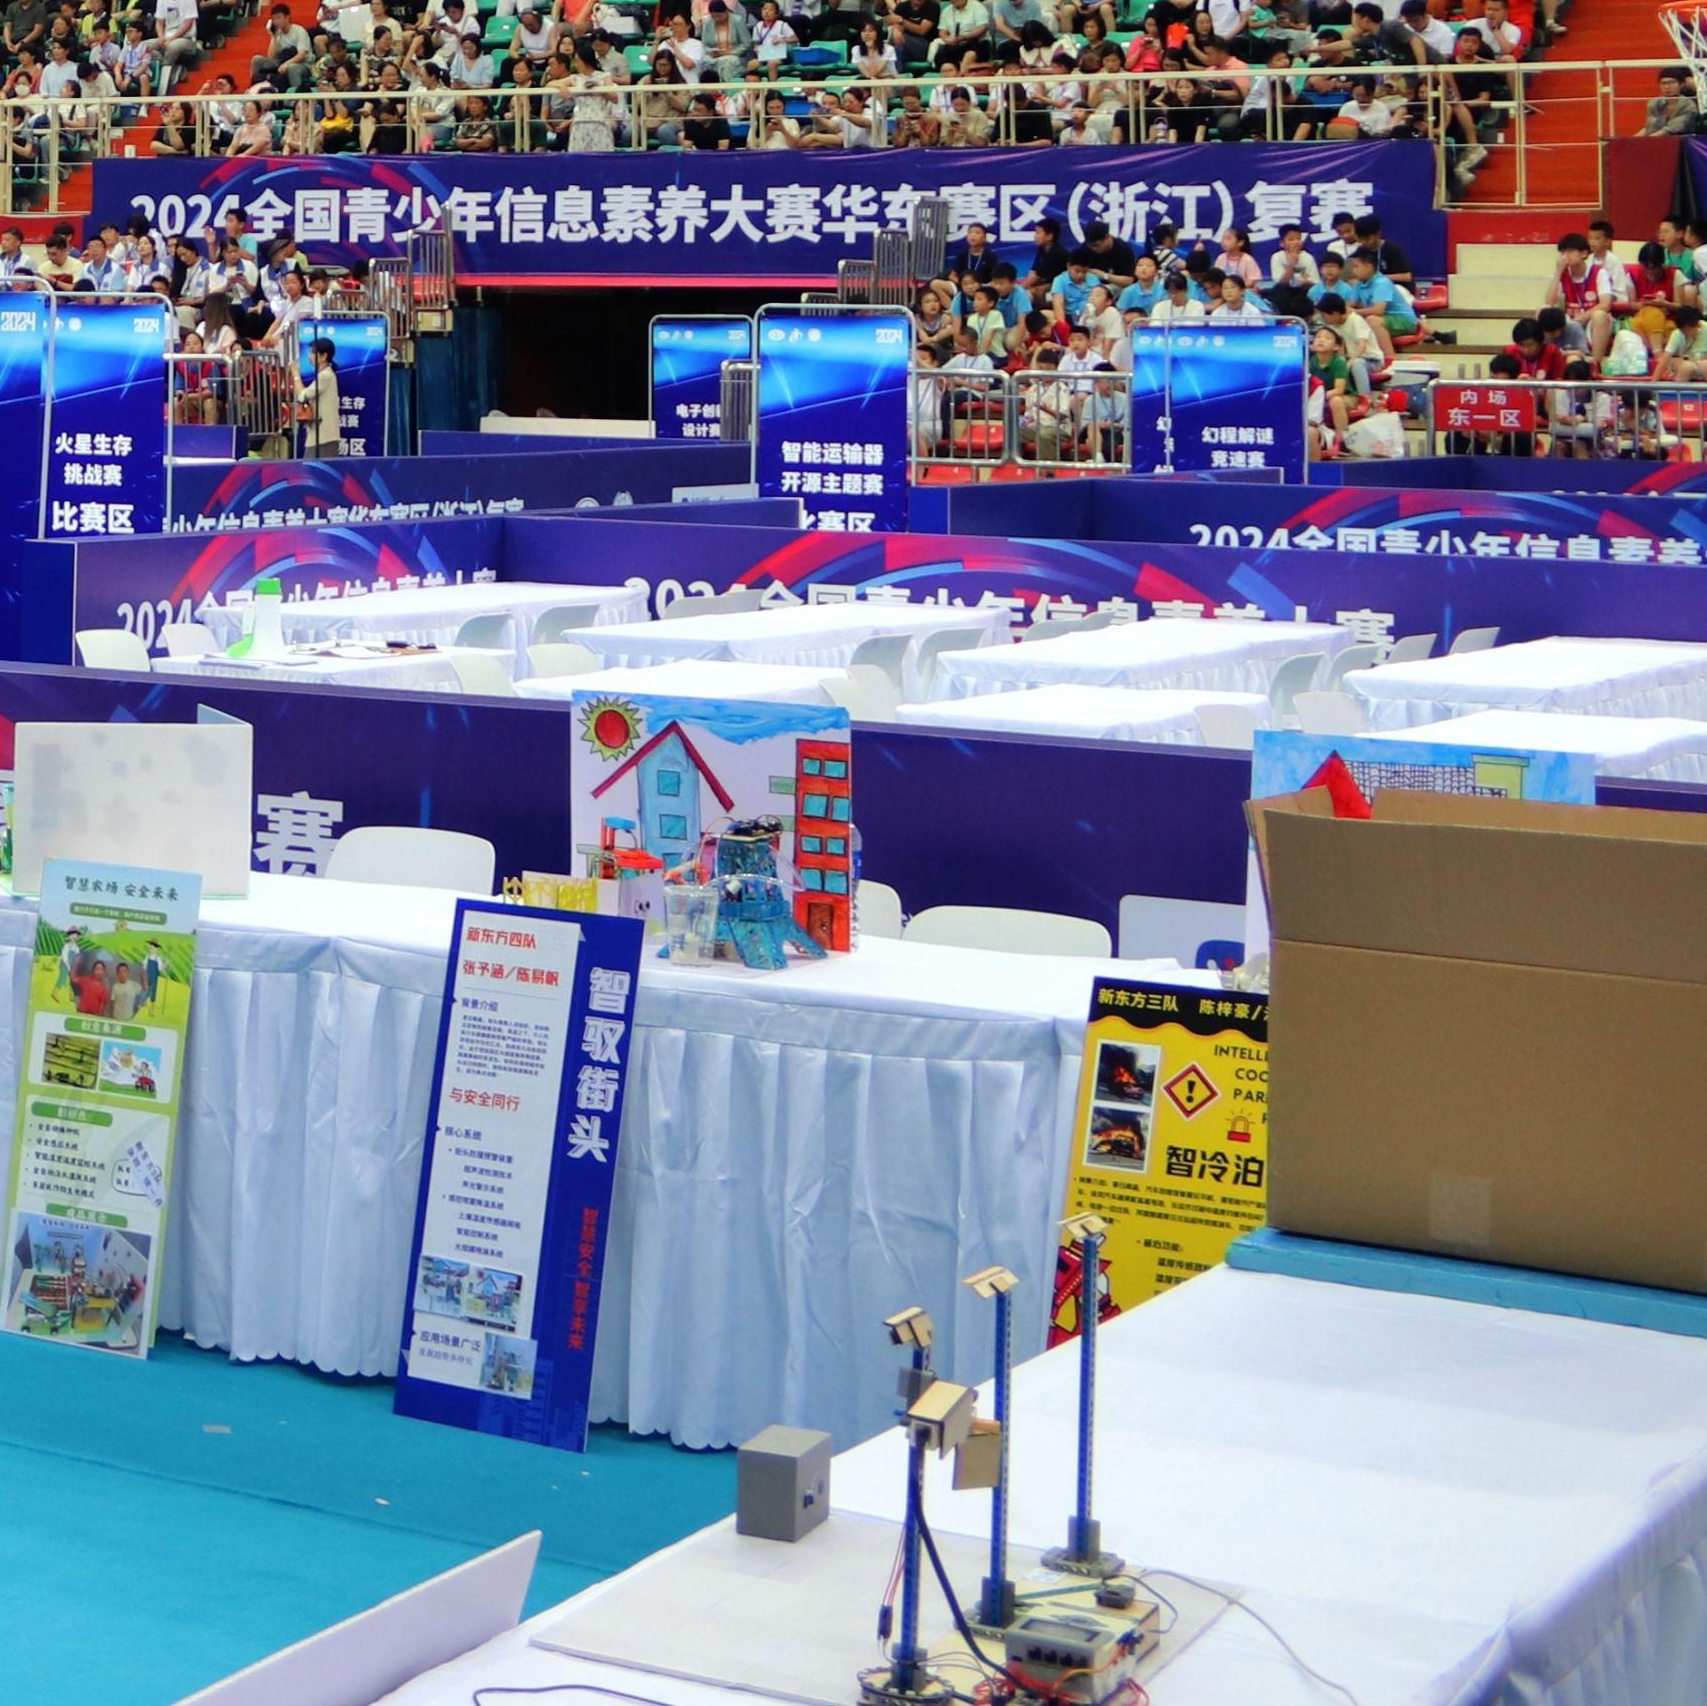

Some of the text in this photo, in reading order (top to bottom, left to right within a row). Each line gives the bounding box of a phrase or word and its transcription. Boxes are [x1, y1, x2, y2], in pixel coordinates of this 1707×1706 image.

[1458, 386, 1509, 407] 内场
[675, 403, 721, 419] 电子创
[1446, 406, 1524, 429] 东一区
[55, 432, 133, 457] 火星生存
[780, 440, 884, 466] 智能运输器
[63, 462, 123, 487] 挑战赛
[780, 471, 884, 496] 开源主题赛
[51, 501, 136, 535] 比赛区
[465, 925, 538, 950] 新东方四队
[460, 997, 500, 1014] 背景介绍
[1097, 987, 1268, 1022] 新东方三队 陈梓豪/
[567, 966, 632, 1164] 智驭街头
[448, 1087, 522, 1112] 与安全同行
[1166, 1145, 1265, 1188] 智冷泊
[419, 1328, 482, 1354] 应用场景广泛
